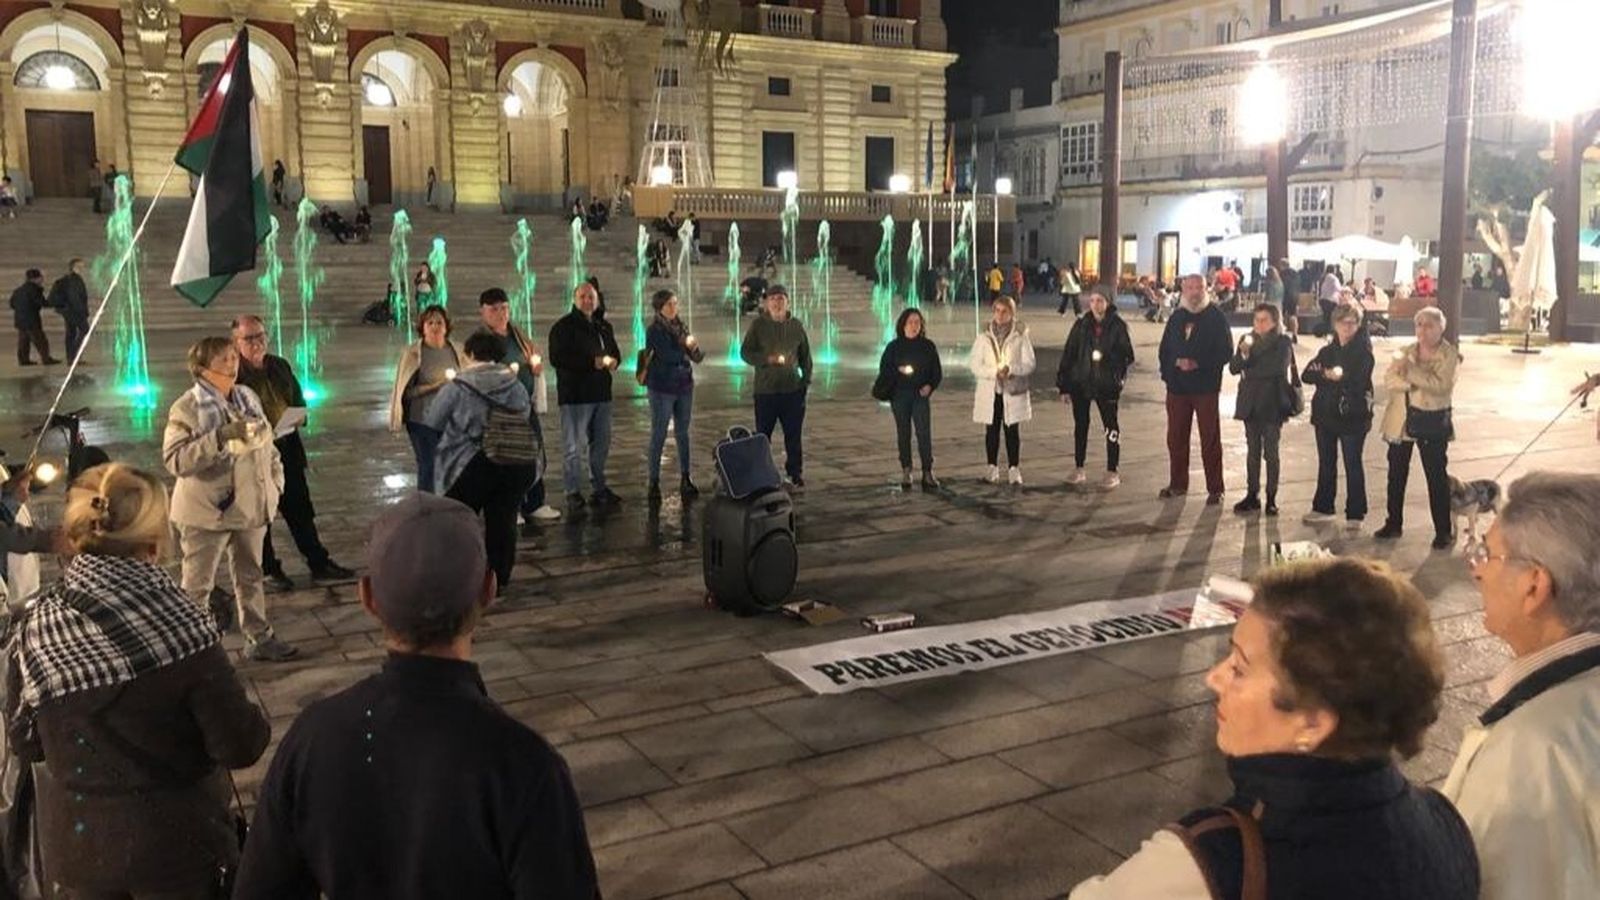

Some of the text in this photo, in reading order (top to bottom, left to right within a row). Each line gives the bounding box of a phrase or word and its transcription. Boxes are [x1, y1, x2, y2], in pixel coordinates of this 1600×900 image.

[813, 643, 984, 685] PAREMOS
[966, 638, 1028, 658] EL
[1010, 614, 1182, 651] GENOCIDIO
